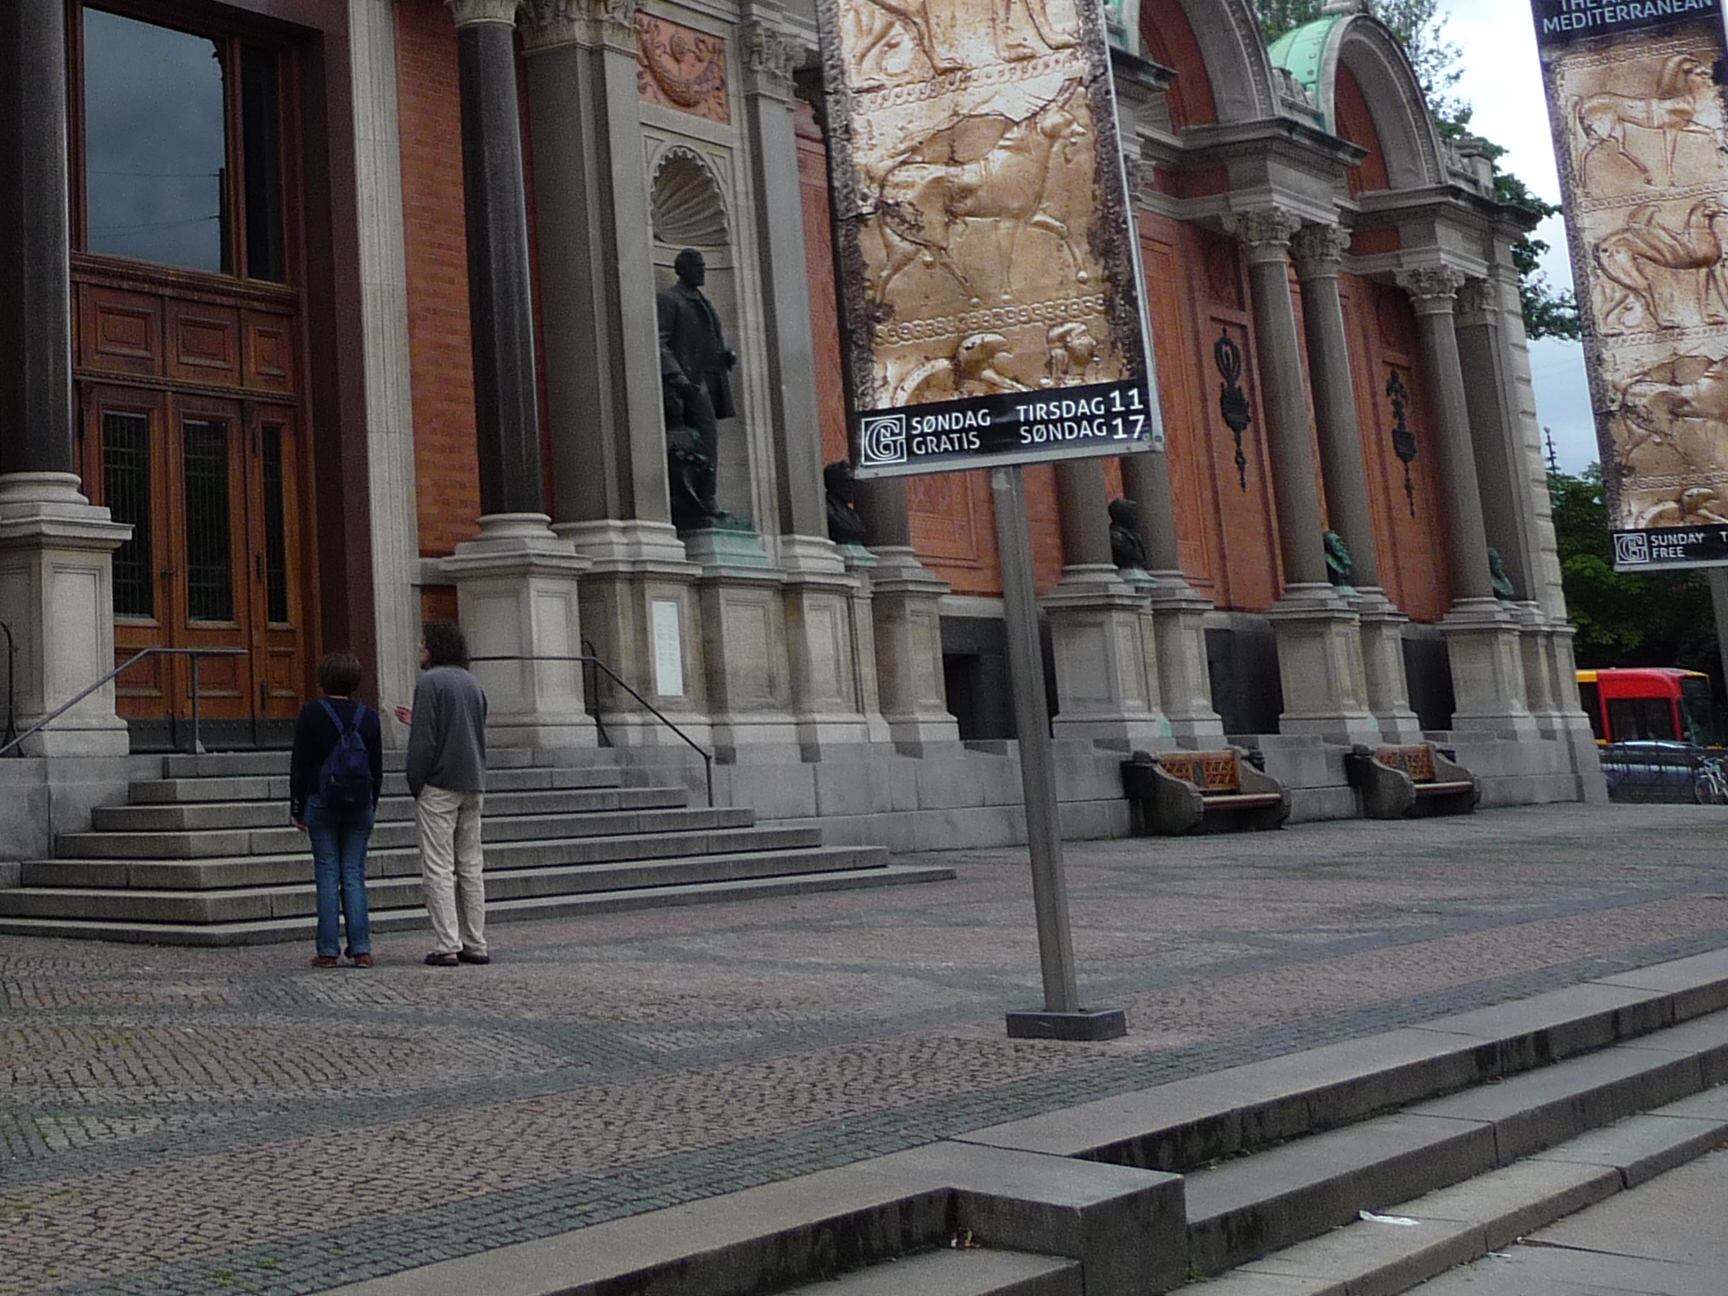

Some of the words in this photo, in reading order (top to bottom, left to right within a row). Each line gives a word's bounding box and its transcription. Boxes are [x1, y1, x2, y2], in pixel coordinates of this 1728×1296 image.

[1016, 397, 1105, 423] TIRSDAG
[1109, 388, 1144, 411] 11
[912, 409, 991, 434] SØNDAG
[1020, 418, 1107, 444] SØNDAG
[1111, 415, 1145, 440] 17
[913, 432, 980, 454] GRATIS
[1650, 533, 1705, 546] SUNDAY
[1652, 547, 1685, 558] FREE
